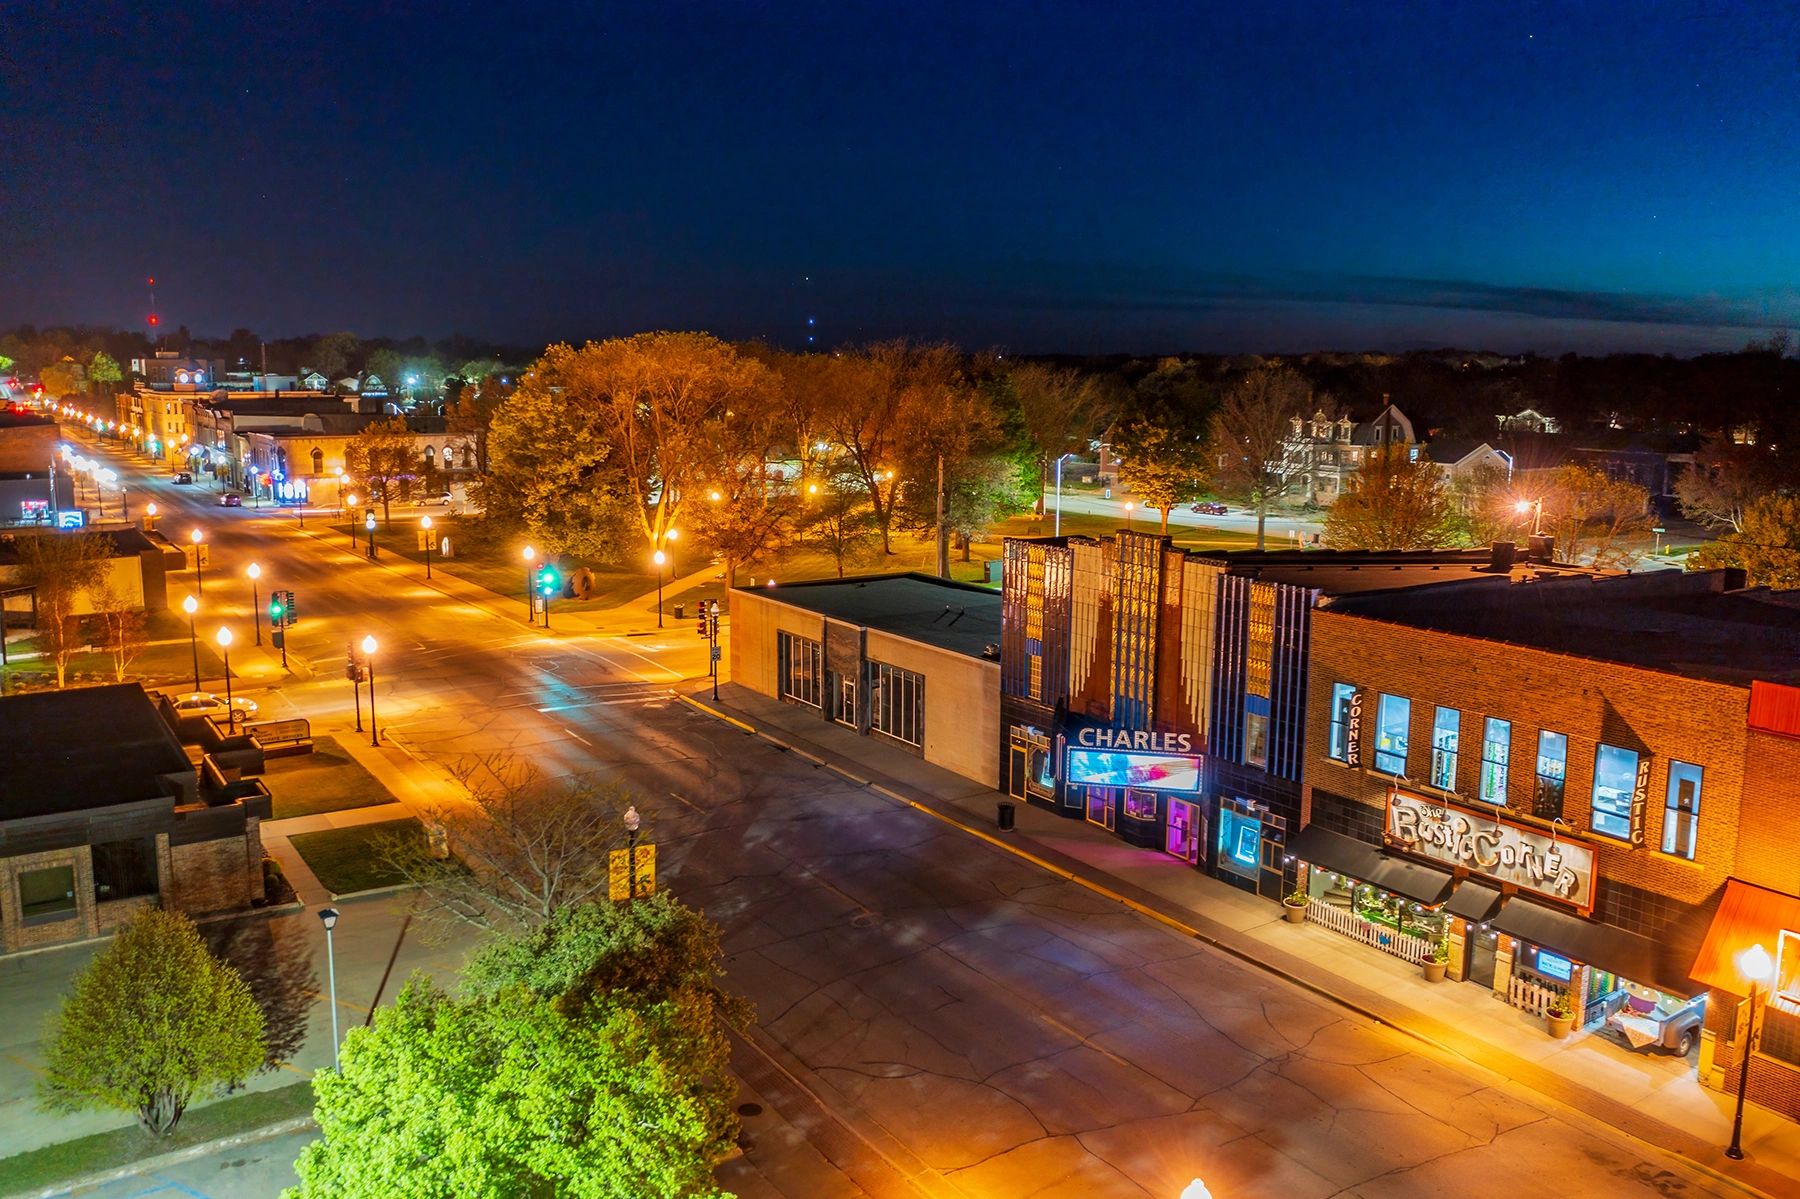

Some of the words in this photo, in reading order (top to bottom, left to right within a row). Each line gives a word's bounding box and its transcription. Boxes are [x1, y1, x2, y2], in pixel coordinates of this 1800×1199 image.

[1078, 727, 1192, 753] CHARLES
[1347, 694, 1362, 765] CORNER
[1419, 805, 1444, 819] The
[1631, 761, 1650, 844] RUSTIC
